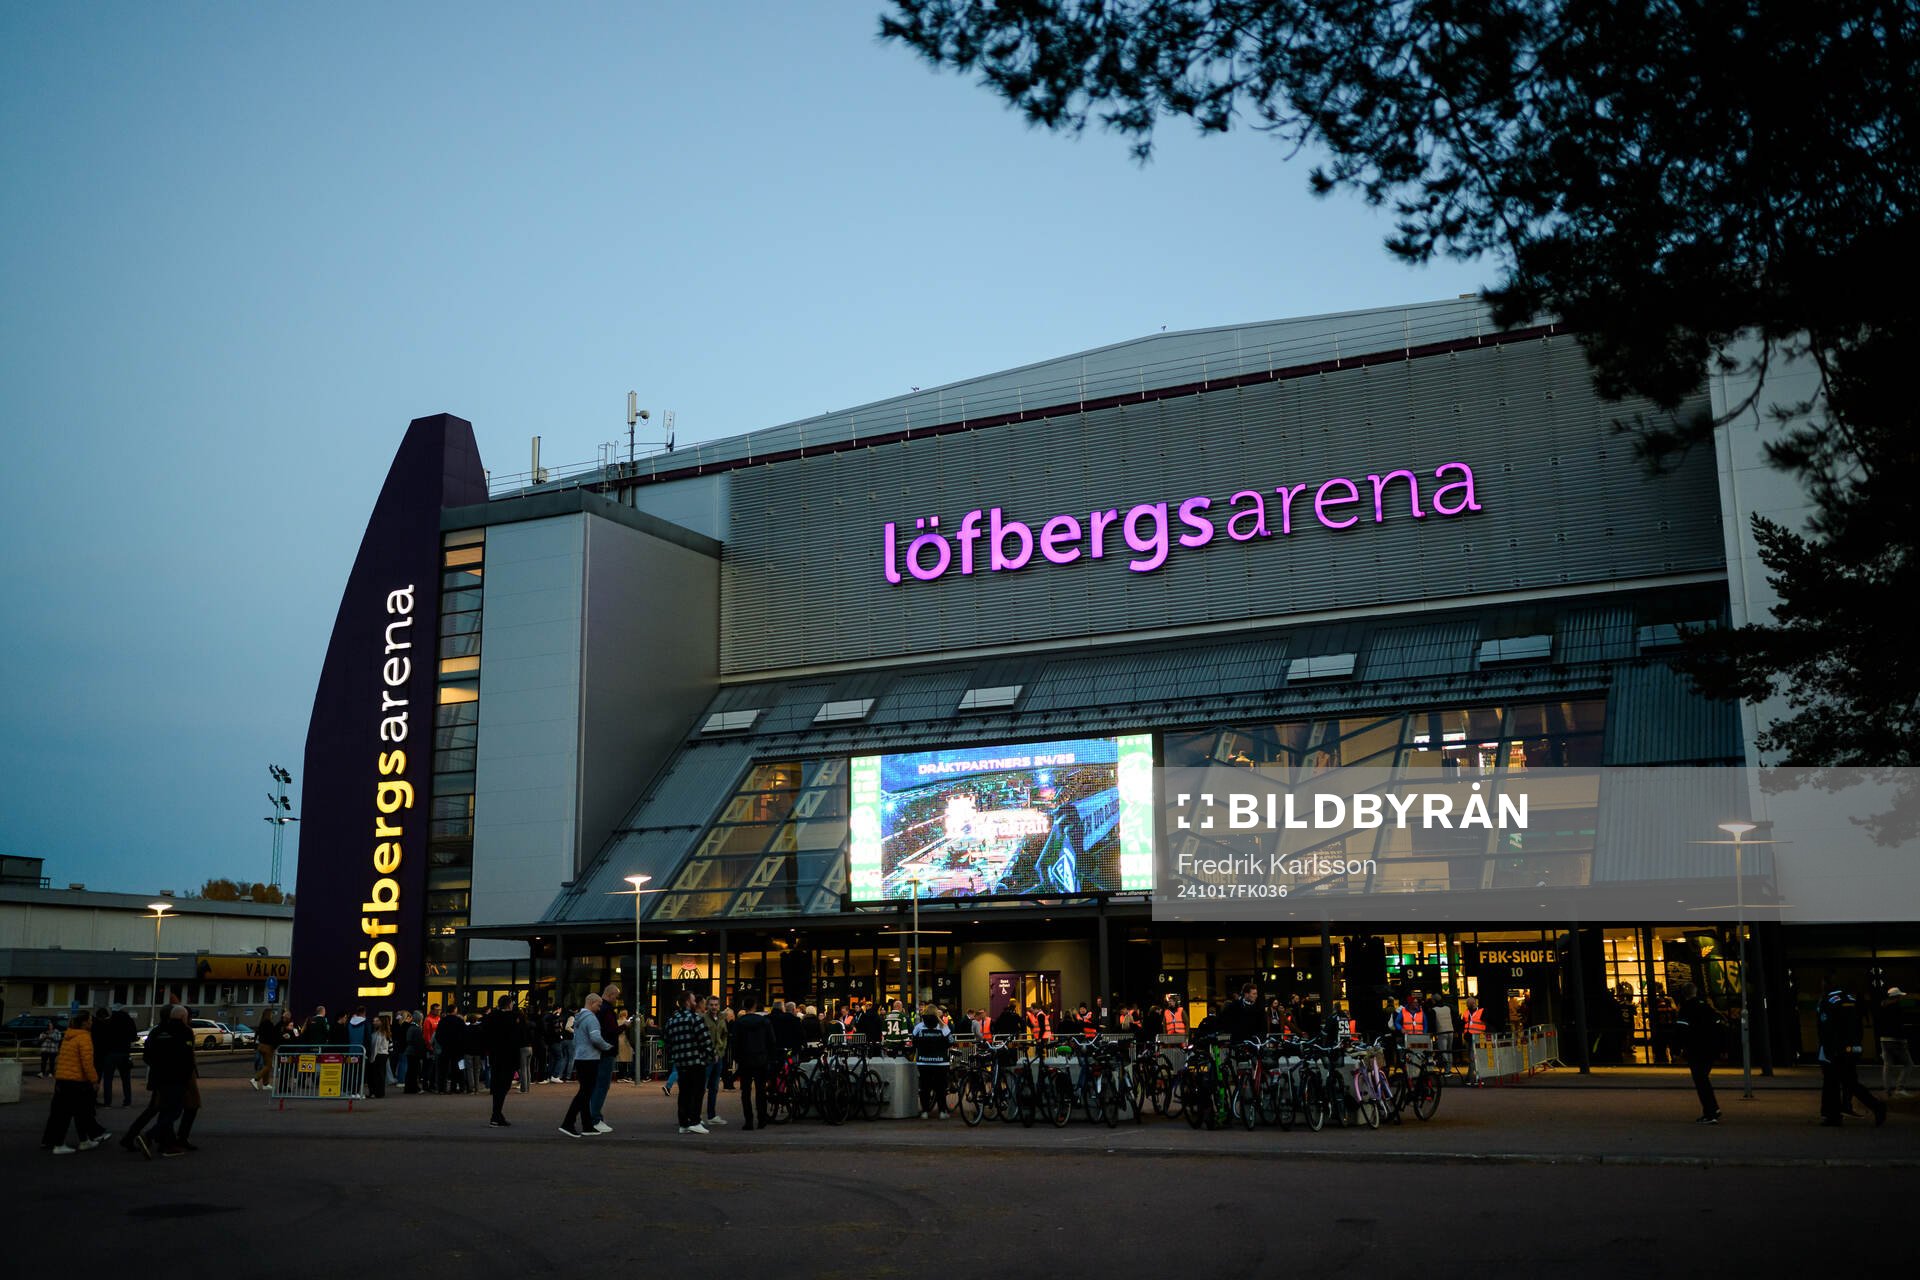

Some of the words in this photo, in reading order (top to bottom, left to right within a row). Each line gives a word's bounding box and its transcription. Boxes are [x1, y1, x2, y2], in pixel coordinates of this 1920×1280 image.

[884, 462, 1481, 584] löfbergsarena
[1262, 972, 1268, 982] 7
[1296, 971, 1303, 981] 8
[1407, 969, 1414, 979] 9
[1511, 967, 1523, 977] 10
[937, 978, 944, 987] 5
[1158, 973, 1165, 983] 6
[739, 981, 746, 991] 2
[822, 980, 828, 989] 3
[850, 979, 857, 989] 4
[886, 1020, 900, 1035] 34
